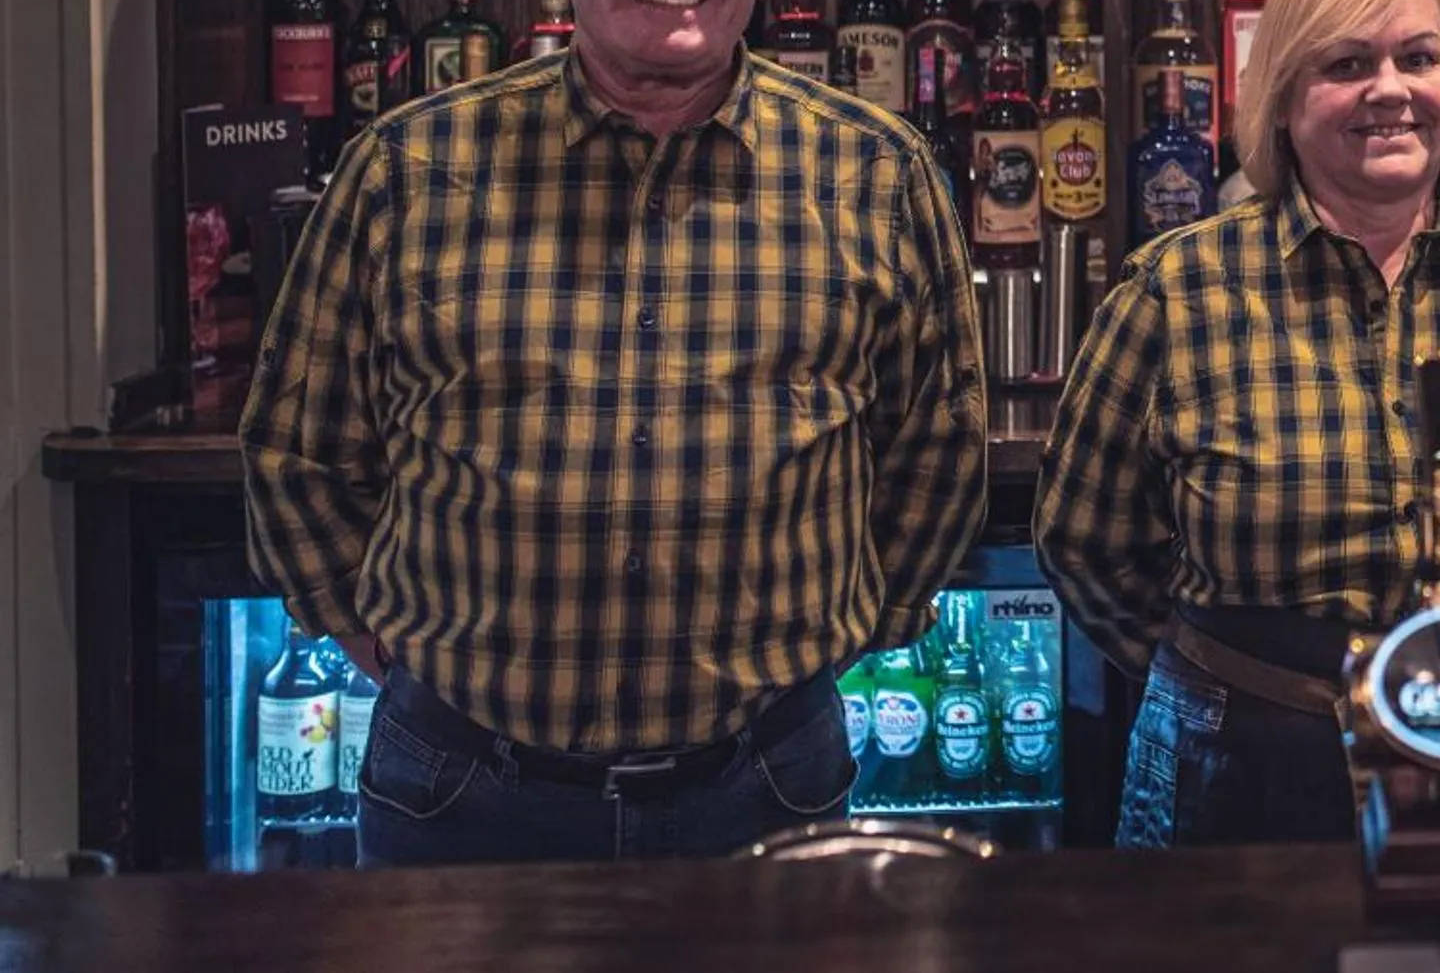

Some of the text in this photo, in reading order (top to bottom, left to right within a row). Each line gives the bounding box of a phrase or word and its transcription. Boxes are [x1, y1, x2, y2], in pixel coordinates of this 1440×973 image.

[841, 31, 900, 49] AMESON
[206, 119, 288, 147] DRINKS
[993, 594, 1054, 616] rhino
